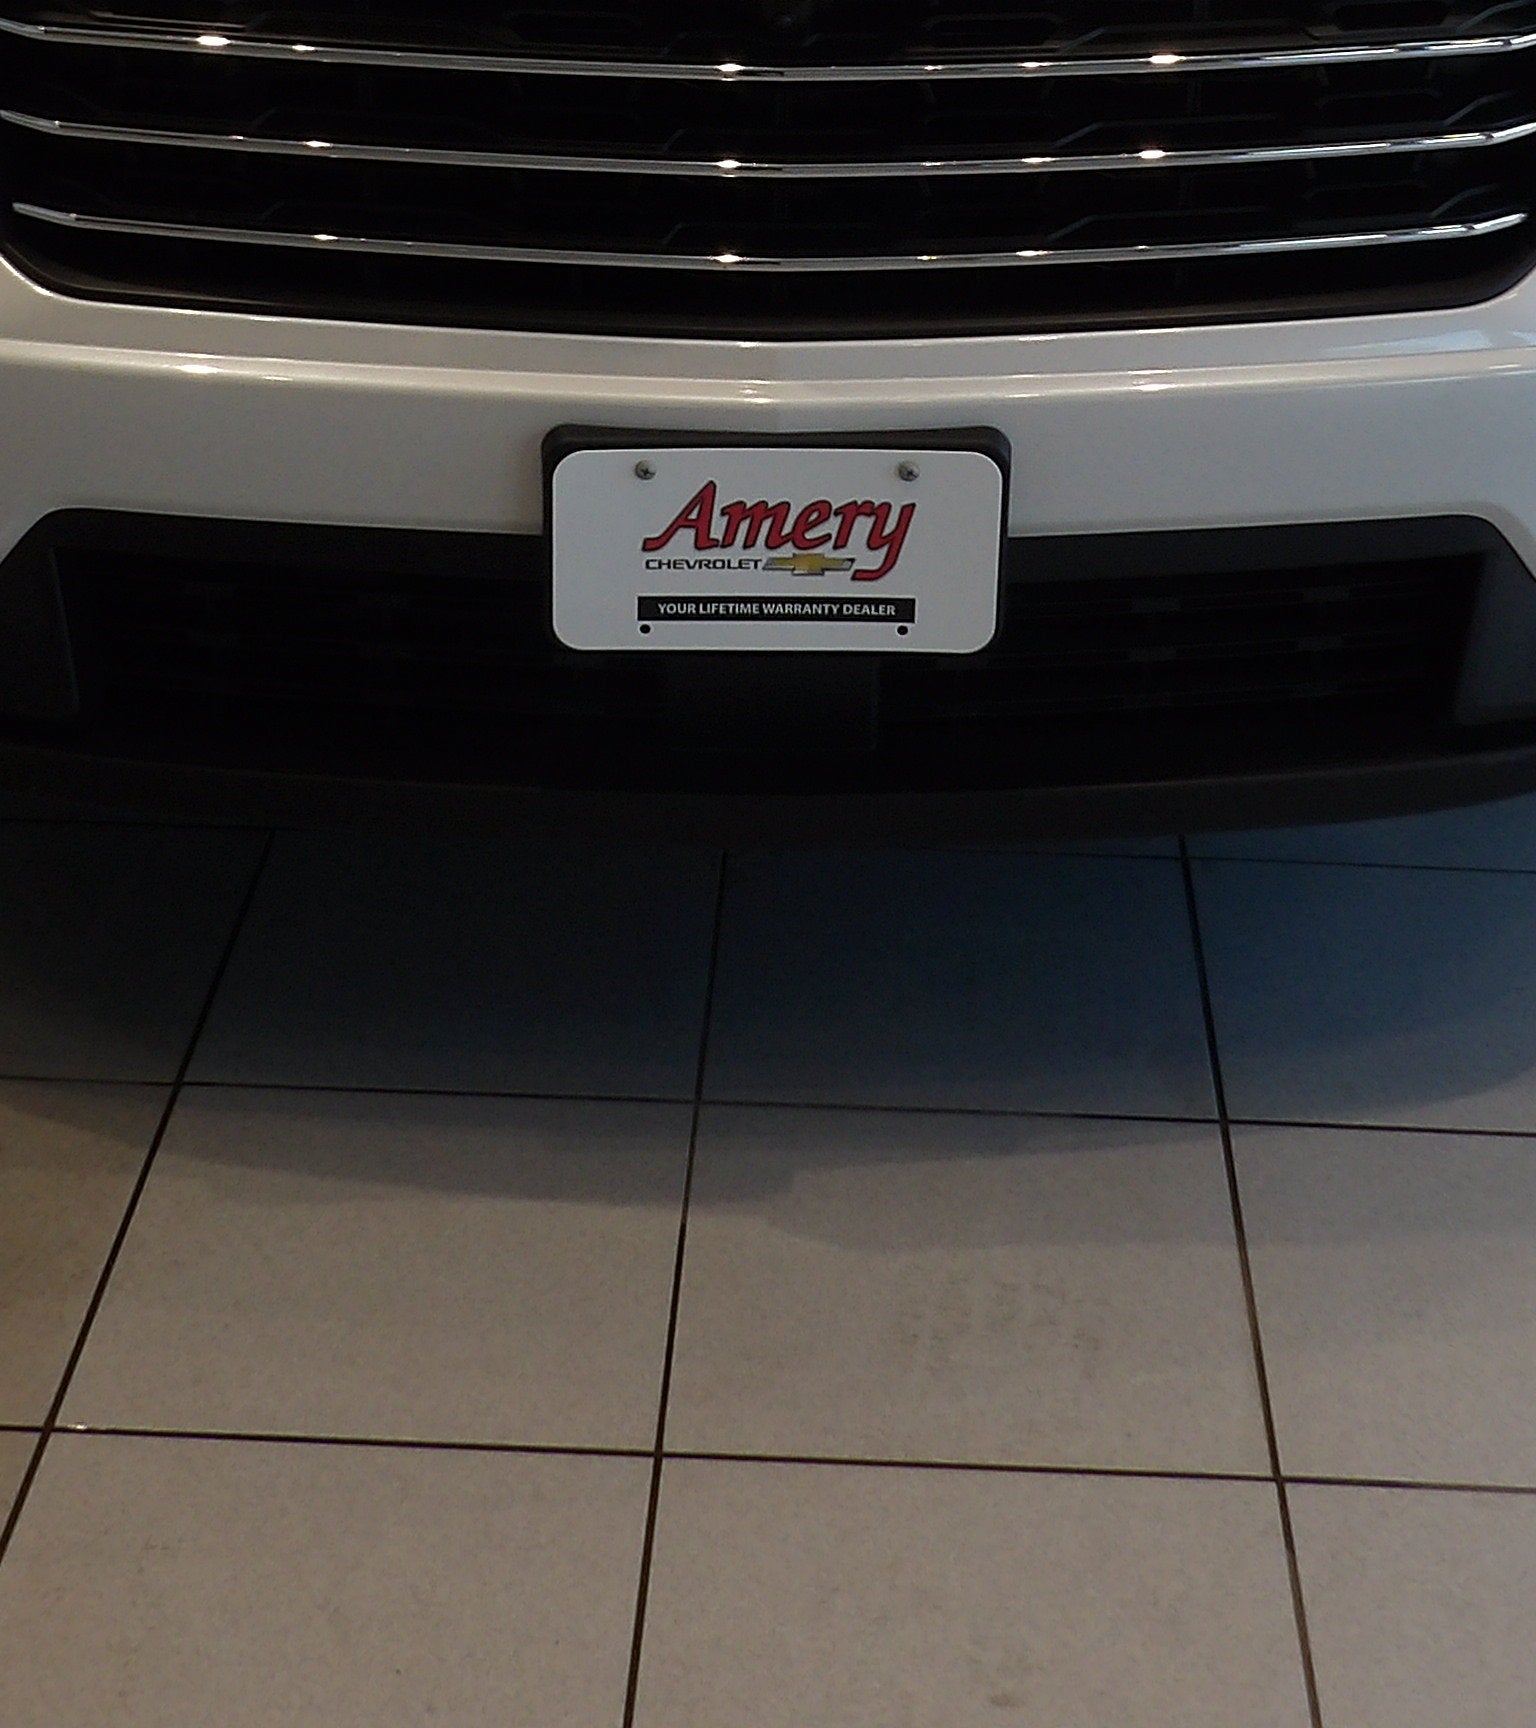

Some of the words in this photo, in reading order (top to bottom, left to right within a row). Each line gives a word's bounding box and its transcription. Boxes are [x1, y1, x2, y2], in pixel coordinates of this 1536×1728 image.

[641, 479, 917, 582] Amery
[644, 558, 763, 571] CHEVROLET
[658, 602, 696, 615] YOUR
[699, 602, 760, 615] LIFETIME
[762, 602, 840, 616] WARRANTY
[843, 603, 896, 616] DEALER
